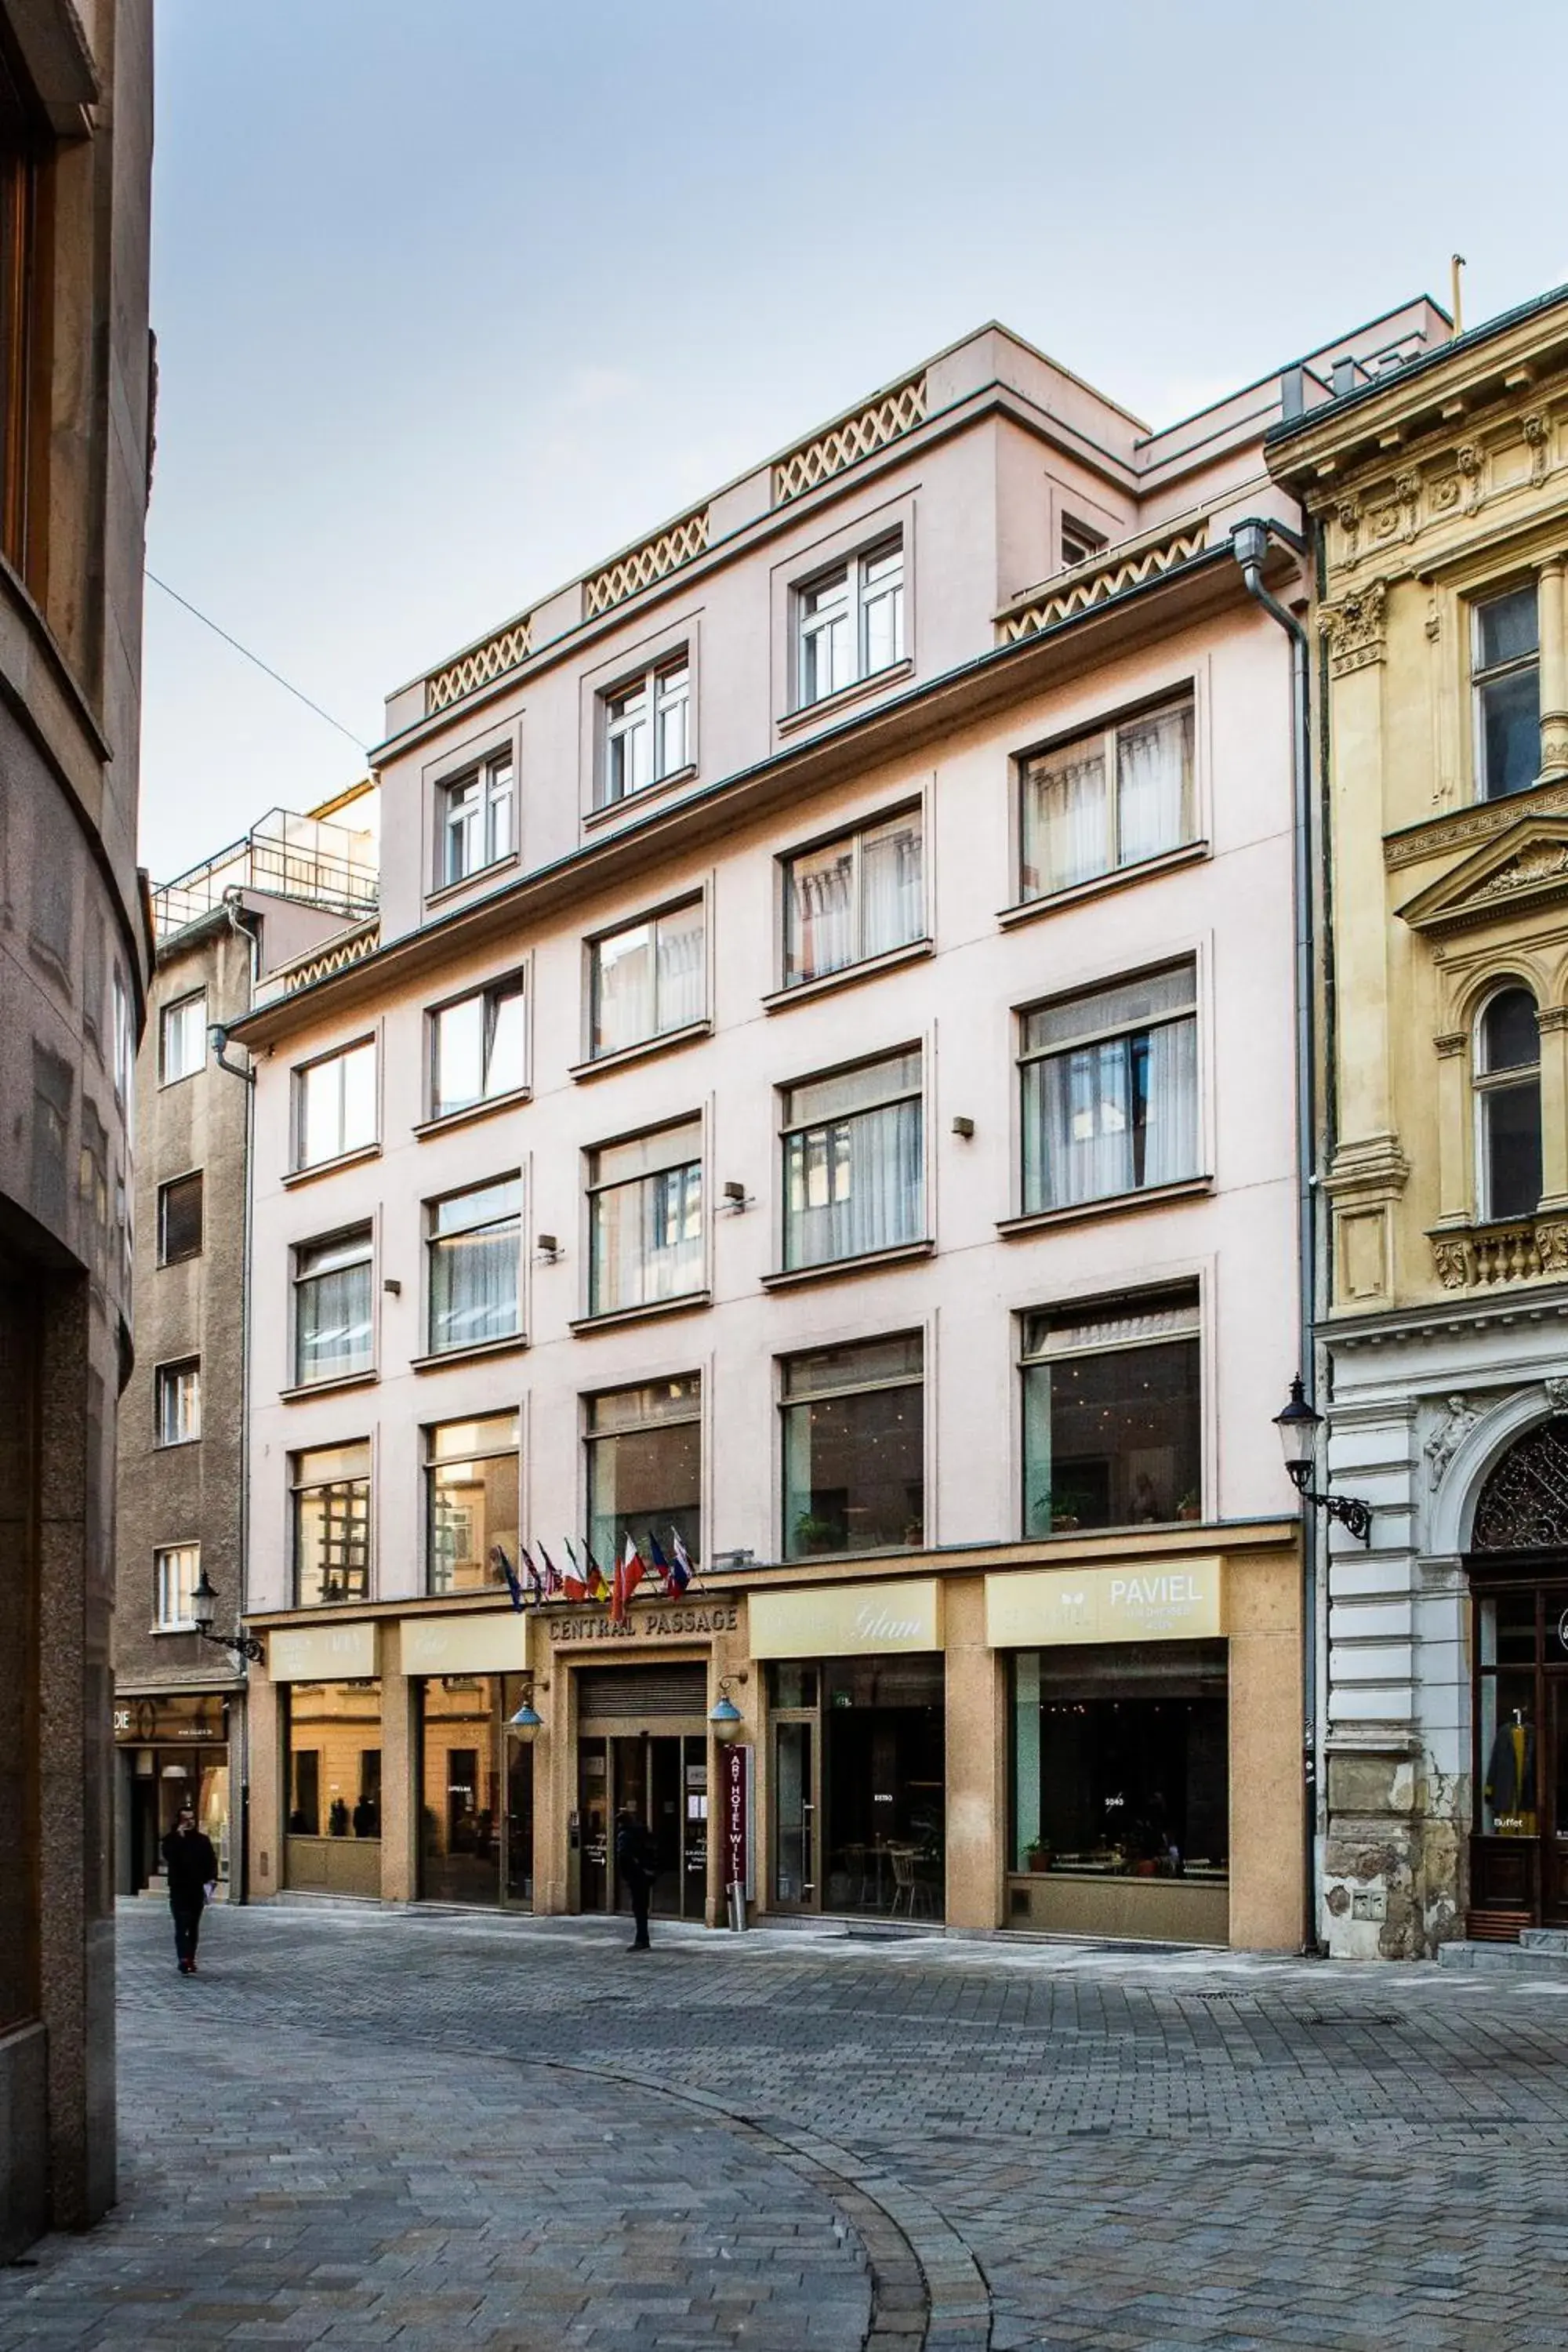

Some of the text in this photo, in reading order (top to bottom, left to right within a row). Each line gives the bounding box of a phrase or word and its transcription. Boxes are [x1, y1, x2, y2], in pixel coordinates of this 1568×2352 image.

[1110, 1575, 1203, 1606] PAVIEL
[549, 1615, 637, 1641] CENTRAL
[645, 1609, 738, 1635] PASSAGE
[729, 1755, 742, 1882] ART HOTEL WILLI
